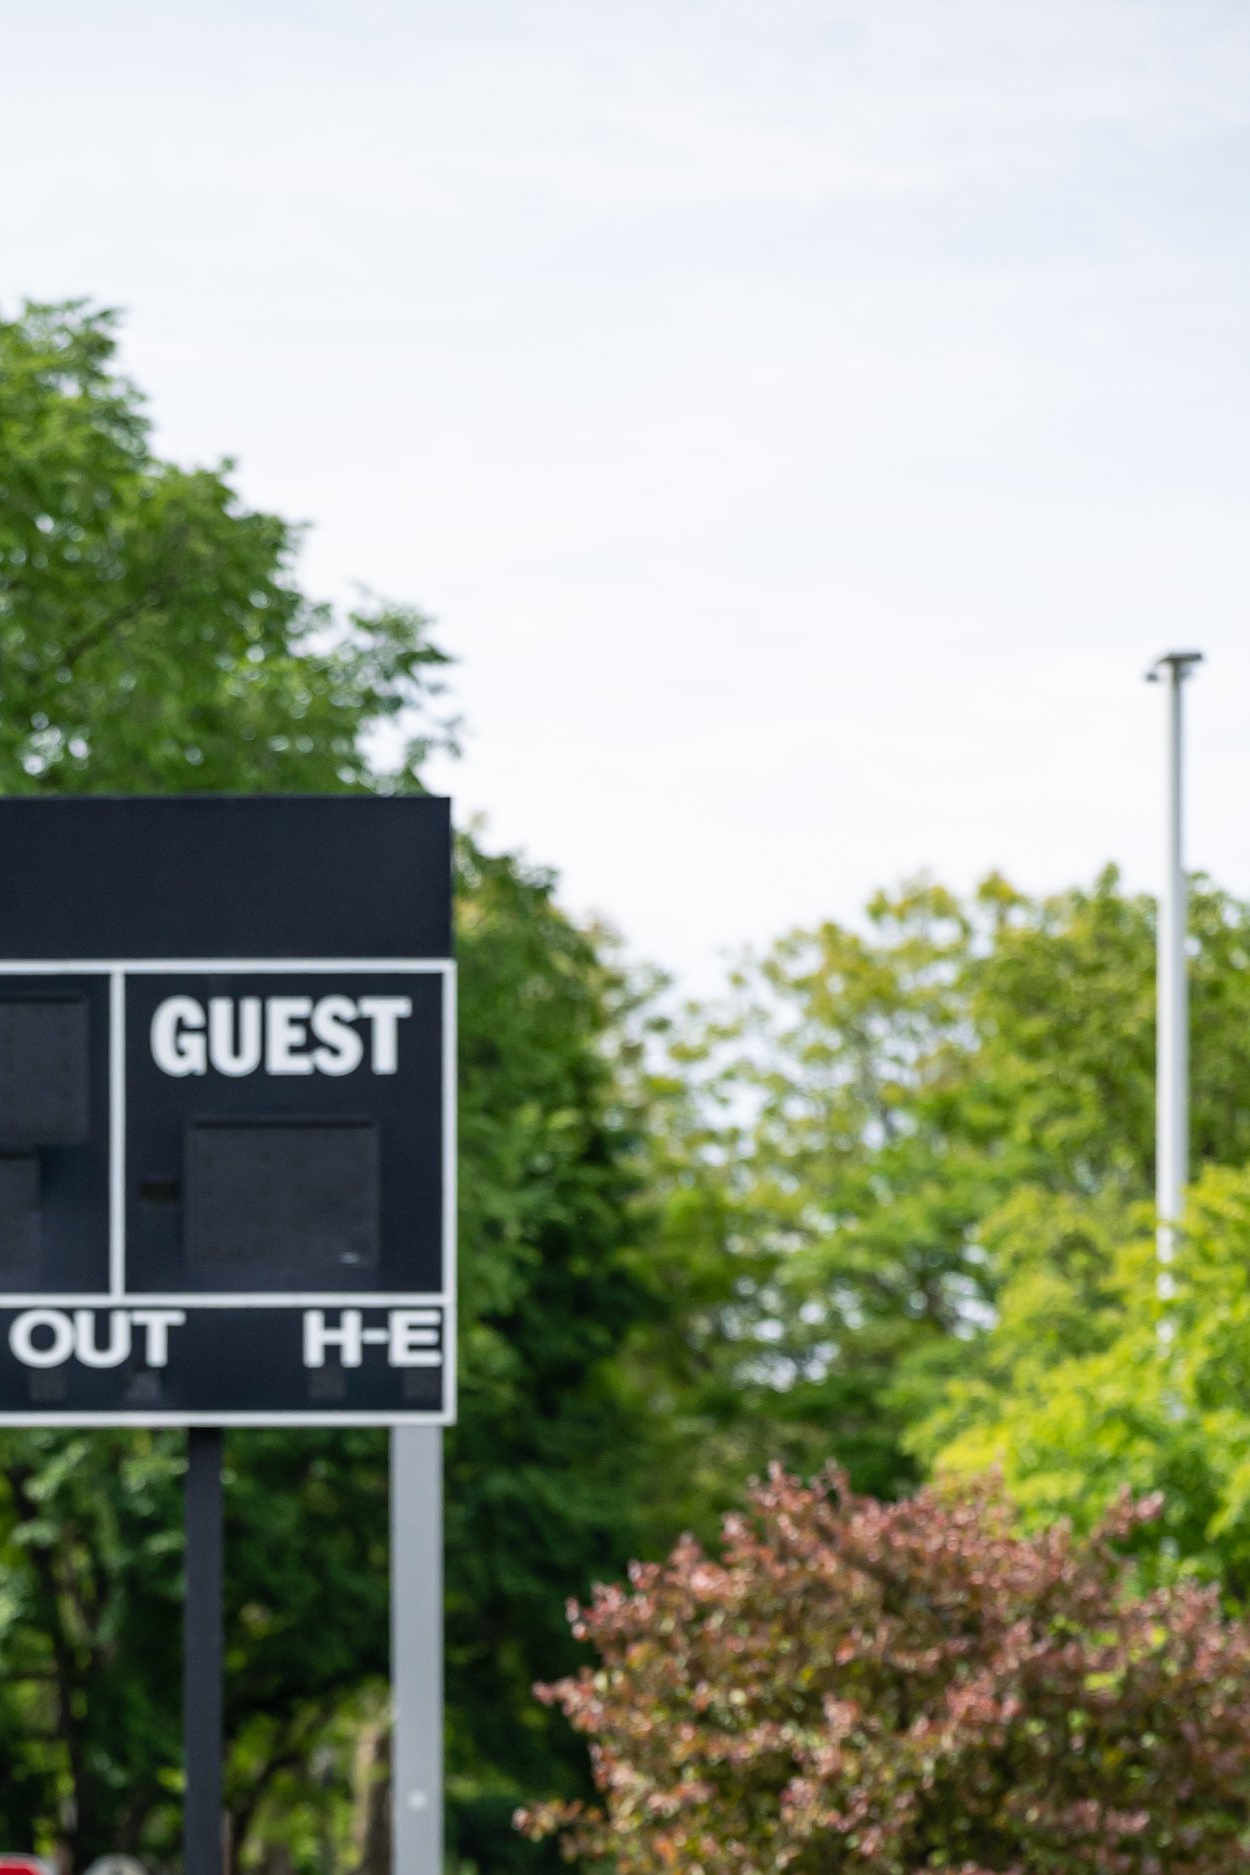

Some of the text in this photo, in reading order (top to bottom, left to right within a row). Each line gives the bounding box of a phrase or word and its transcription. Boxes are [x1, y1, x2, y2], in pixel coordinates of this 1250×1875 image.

[150, 995, 413, 1078] GUEST
[8, 1309, 187, 1369] OUT
[303, 1310, 443, 1368] H-E
